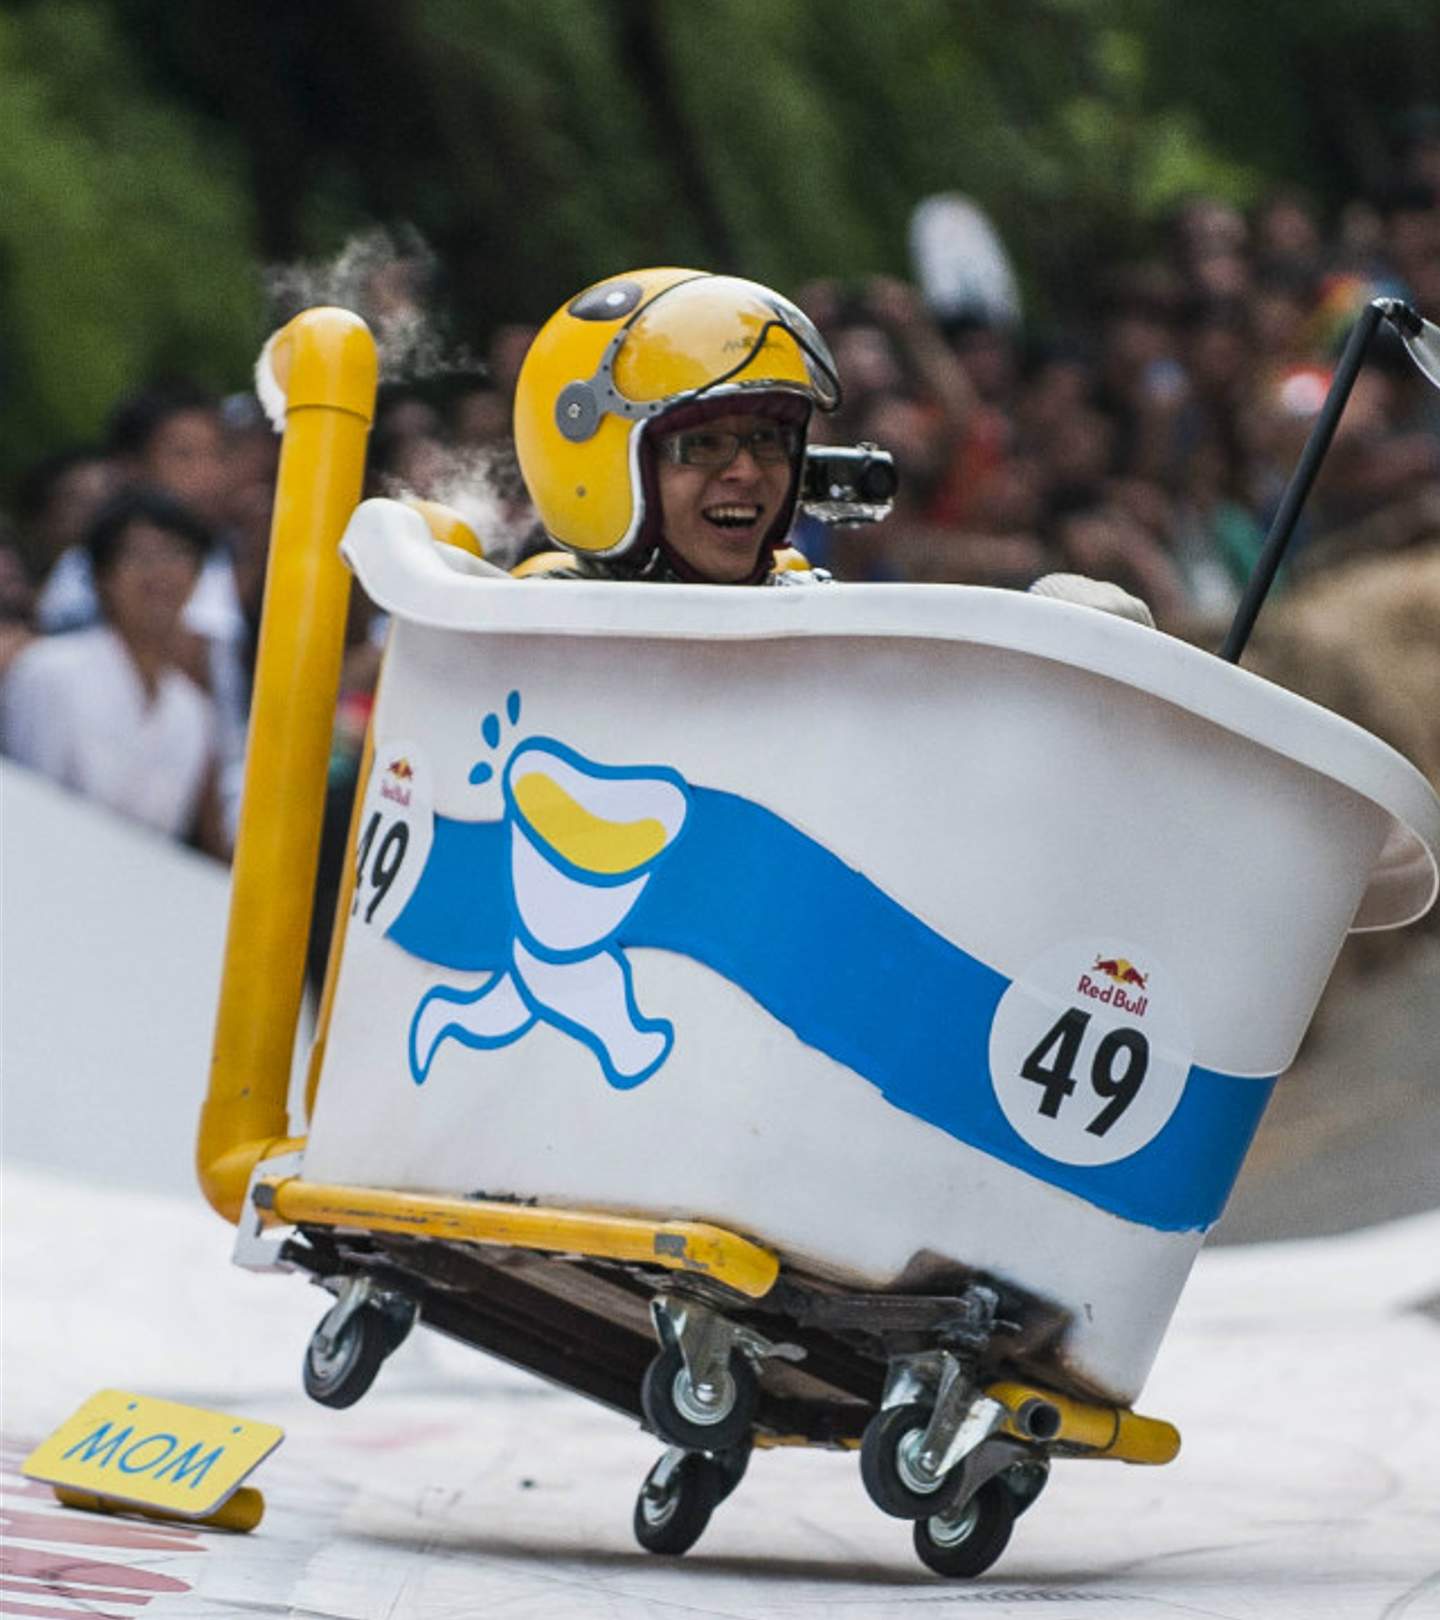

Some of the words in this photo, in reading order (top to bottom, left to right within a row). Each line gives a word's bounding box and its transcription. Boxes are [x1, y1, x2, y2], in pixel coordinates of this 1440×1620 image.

[1076, 975, 1114, 1003] Red
[1112, 988, 1148, 1017] Bull
[1020, 1006, 1150, 1138] 49
[60, 1421, 226, 1489] MOM
